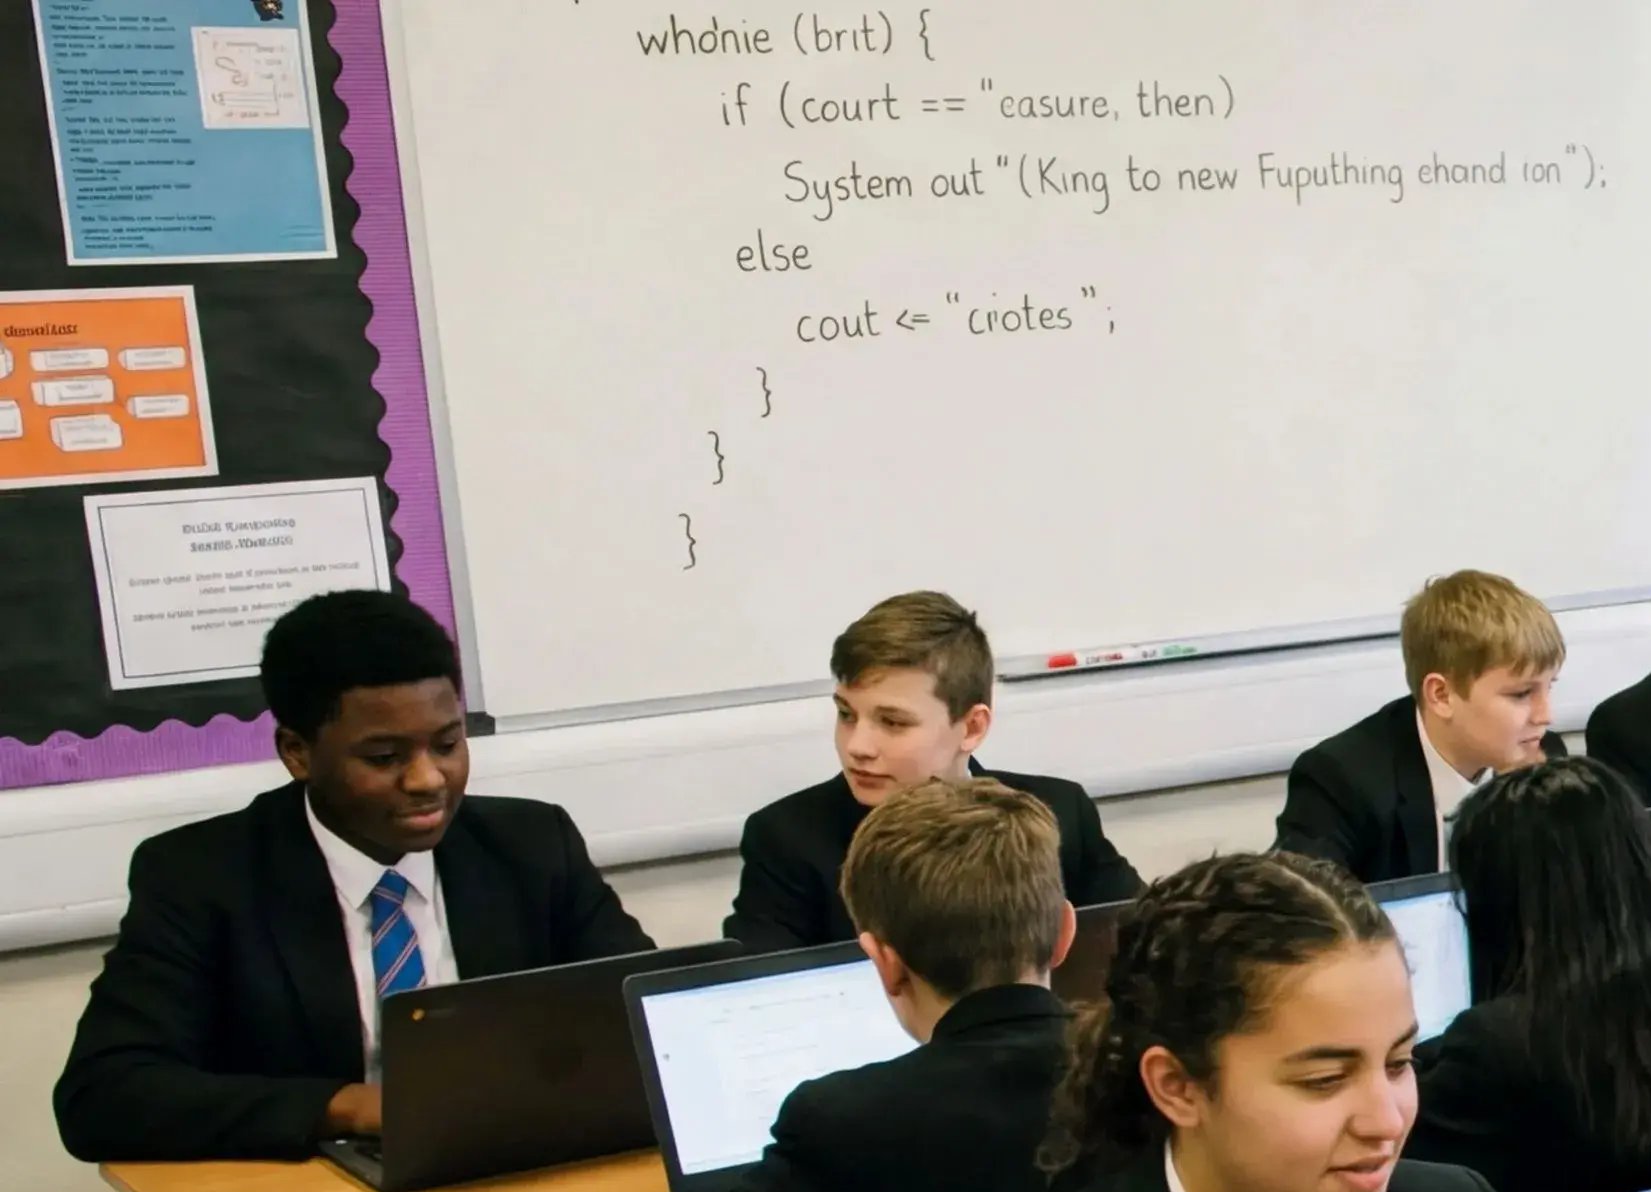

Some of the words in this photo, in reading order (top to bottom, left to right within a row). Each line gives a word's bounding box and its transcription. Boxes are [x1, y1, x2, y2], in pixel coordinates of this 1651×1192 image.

[793, 10, 893, 56] (brit)
[918, 7, 936, 62] {
[720, 81, 752, 127] if
[779, 80, 901, 130] (court
[920, 97, 967, 113] ==
[1136, 74, 1235, 120] then)
[783, 159, 913, 223] System
[930, 157, 985, 199] out
[1125, 154, 1162, 193] to
[1177, 167, 1238, 191] new
[1257, 151, 1404, 206] Fuputhing
[735, 227, 813, 273] else
[796, 299, 881, 344] cout
[895, 308, 931, 332] <=
[755, 366, 773, 419] }
[706, 430, 726, 486] }
[677, 512, 697, 571] }
